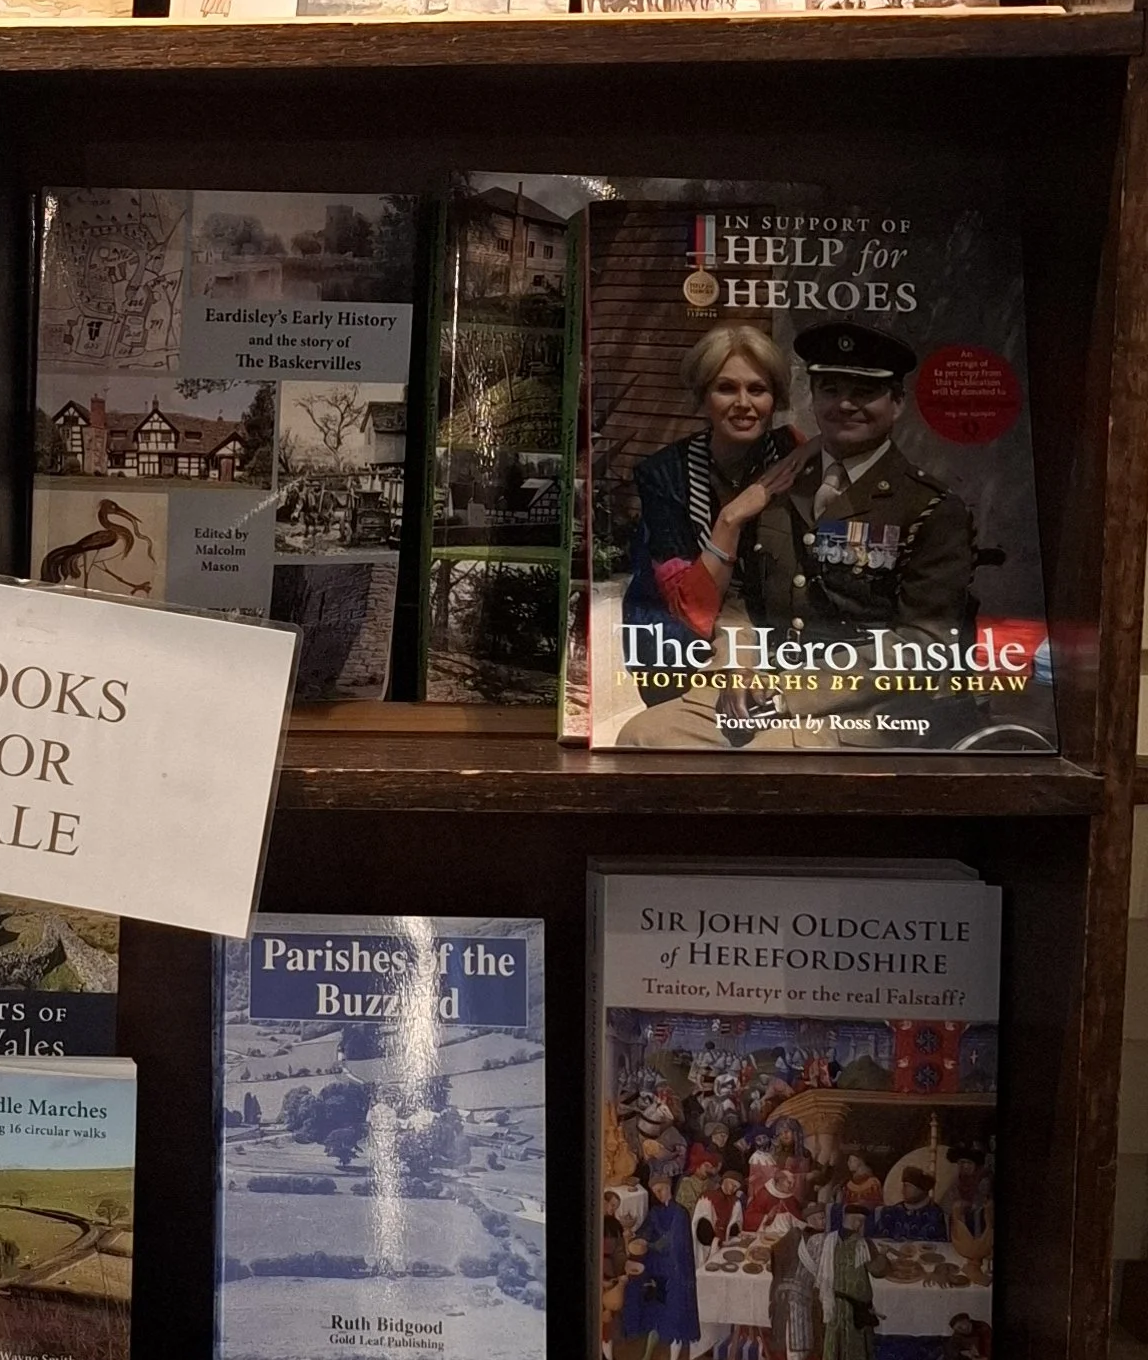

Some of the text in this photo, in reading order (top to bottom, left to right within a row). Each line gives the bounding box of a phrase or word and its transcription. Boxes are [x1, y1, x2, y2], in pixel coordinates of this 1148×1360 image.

[722, 236, 908, 276] HELP for
[722, 277, 919, 313] HEROES
[204, 307, 398, 331] Eardisley's Early History
[612, 621, 1028, 673] The Hero Inside
[639, 907, 971, 942] SIR JOHN OLDCASTLE
[262, 938, 515, 977] Parishes the
[660, 941, 948, 976] of HEREFORDSHIRE
[38, 1005, 68, 1023] OF
[28, 1098, 108, 1119] Marches
[330, 1313, 443, 1336] Ruth Bidgood
